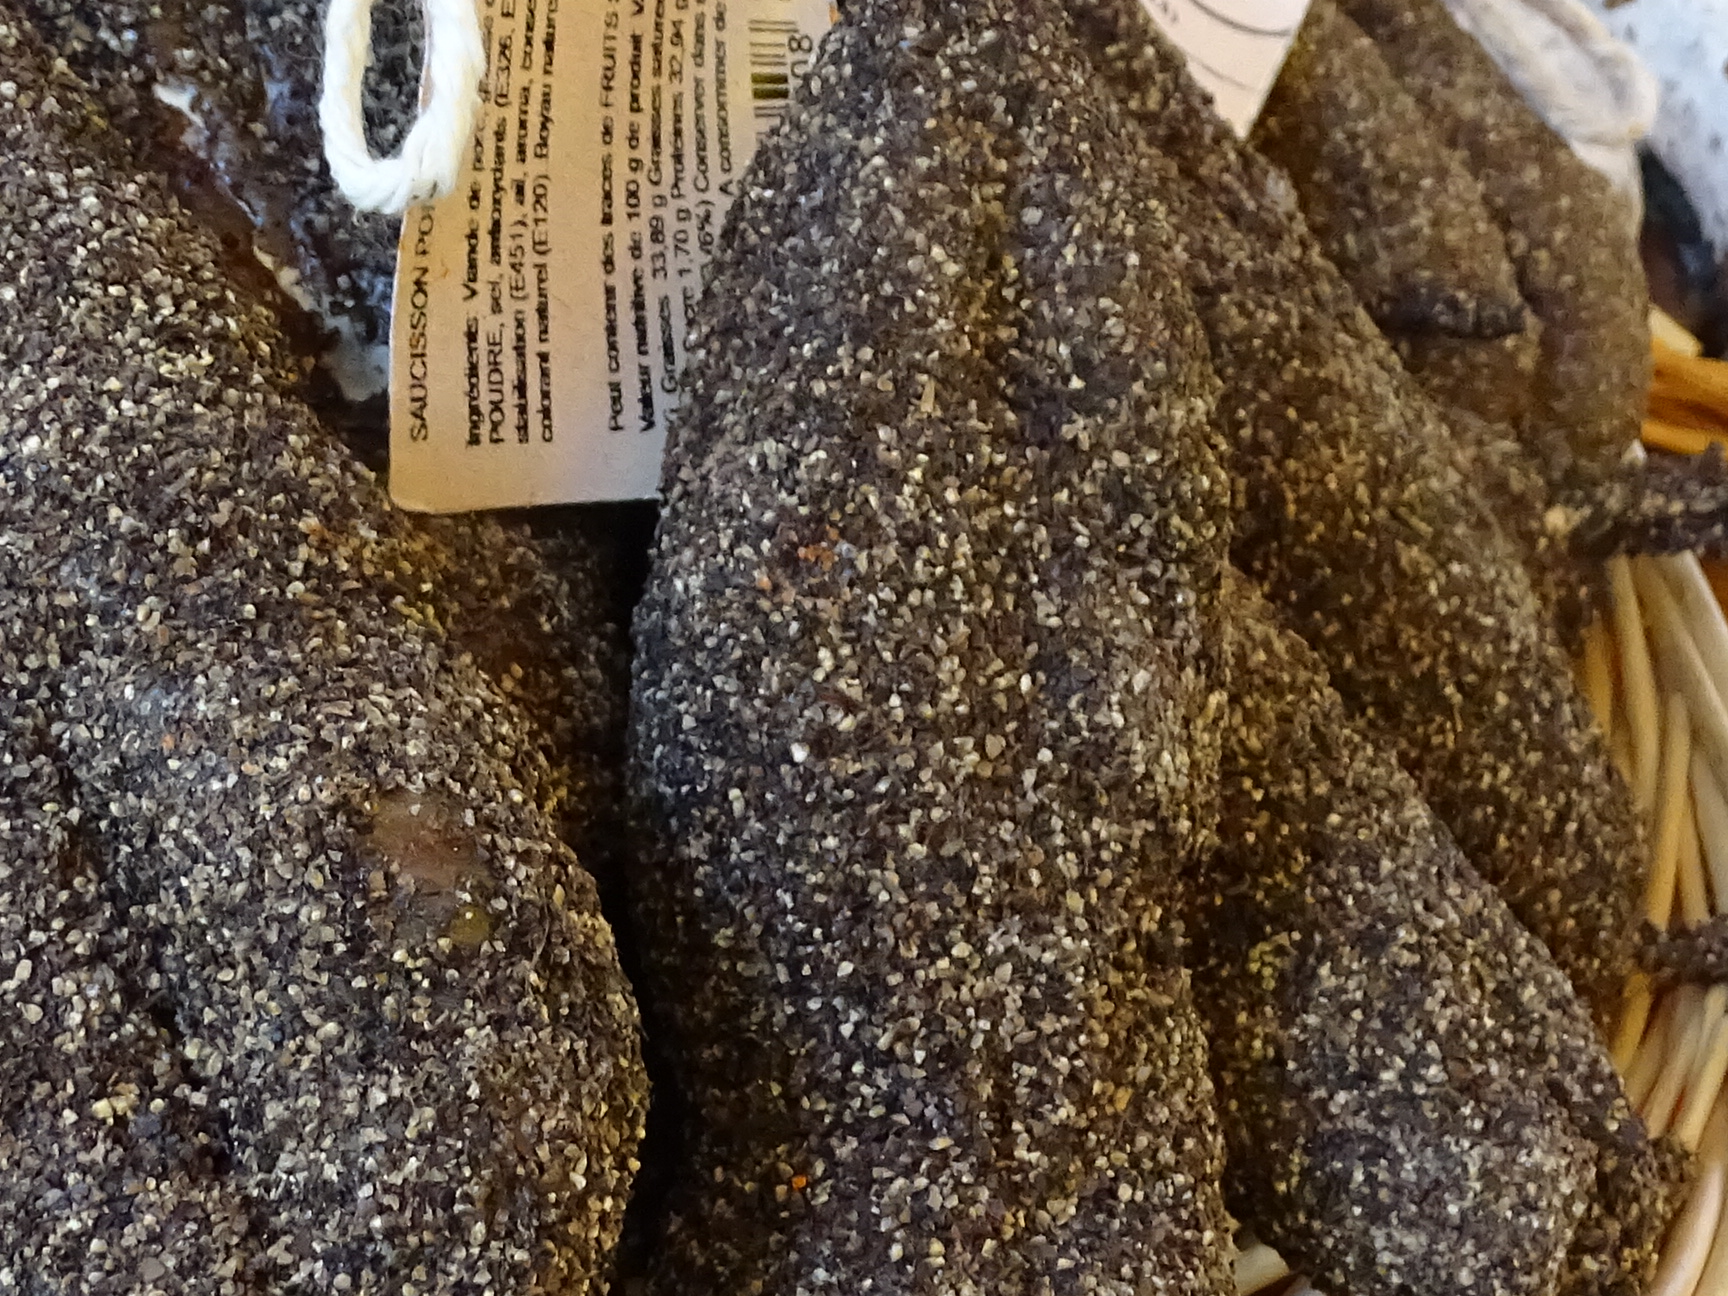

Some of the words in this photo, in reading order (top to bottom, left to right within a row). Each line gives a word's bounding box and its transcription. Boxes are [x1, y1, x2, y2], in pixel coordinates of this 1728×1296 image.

[599, 11, 618, 108] FRUITS
[690, 13, 708, 68] dans
[625, 32, 644, 114] produit
[533, 82, 555, 159] Boyau
[600, 117, 615, 146] de
[626, 122, 642, 150] de
[692, 76, 711, 194] Conserver
[600, 154, 615, 226] traces
[627, 158, 644, 173] g
[719, 179, 734, 197] A
[625, 179, 642, 222] 100
[650, 194, 668, 209] g
[674, 207, 692, 222] g
[600, 234, 616, 274] des
[627, 231, 643, 259] de
[649, 214, 669, 281] 33,89
[674, 229, 692, 279] 1,70
[532, 262, 550, 343] naturel
[601, 283, 620, 373] contenir
[408, 266, 428, 443] SAUCISSON
[486, 323, 505, 444] POUDRE,
[534, 349, 553, 443] colorant
[605, 382, 625, 431] Peut
[634, 364, 655, 432] Valeur
